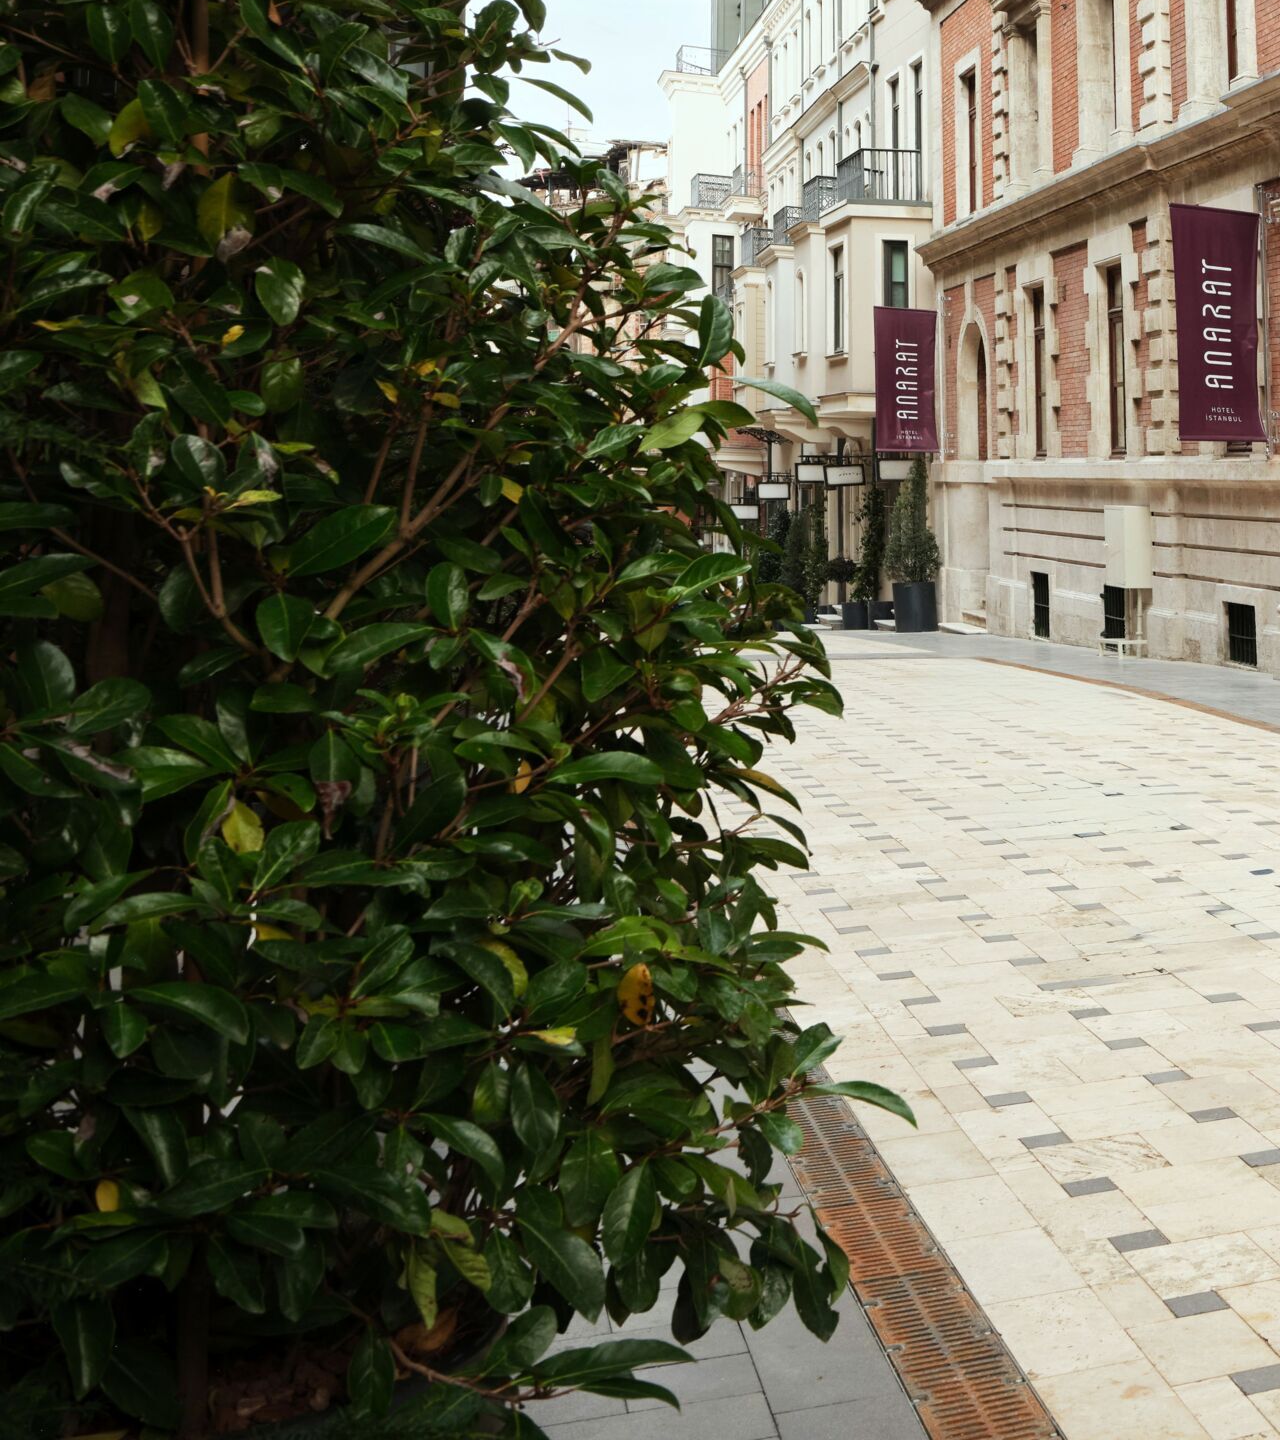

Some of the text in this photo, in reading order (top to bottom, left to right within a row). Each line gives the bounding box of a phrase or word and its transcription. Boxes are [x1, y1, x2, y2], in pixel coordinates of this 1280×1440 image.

[1201, 258, 1234, 389] ANARAT
[895, 338, 919, 420] ANARAT
[1211, 406, 1235, 414] HOTEL
